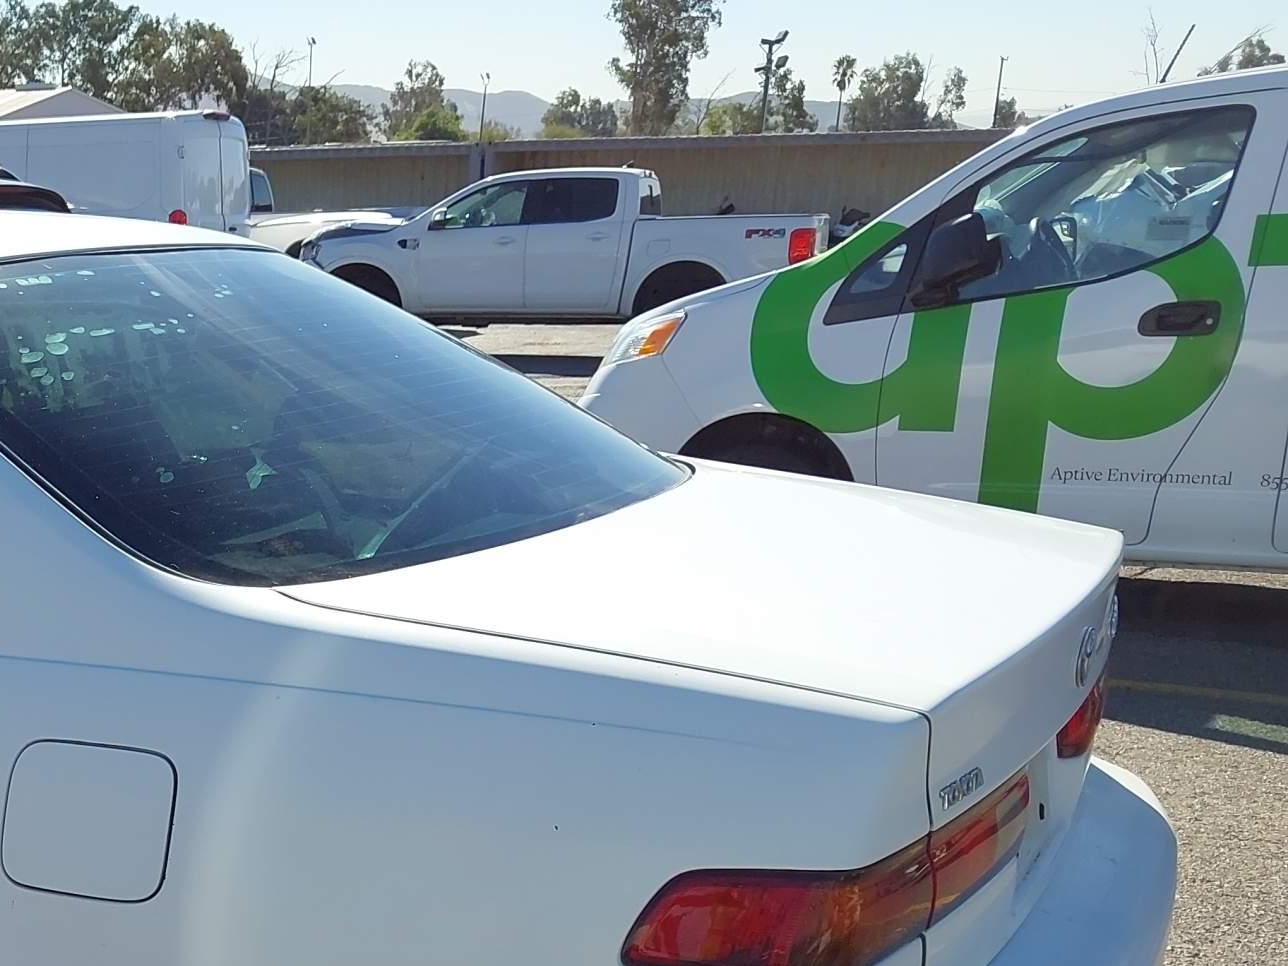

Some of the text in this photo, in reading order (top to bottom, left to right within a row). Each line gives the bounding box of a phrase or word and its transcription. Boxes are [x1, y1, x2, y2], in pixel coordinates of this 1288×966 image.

[750, 213, 1288, 513] ap
[1050, 467, 1103, 484] Aptive
[1107, 468, 1232, 486] Environmental
